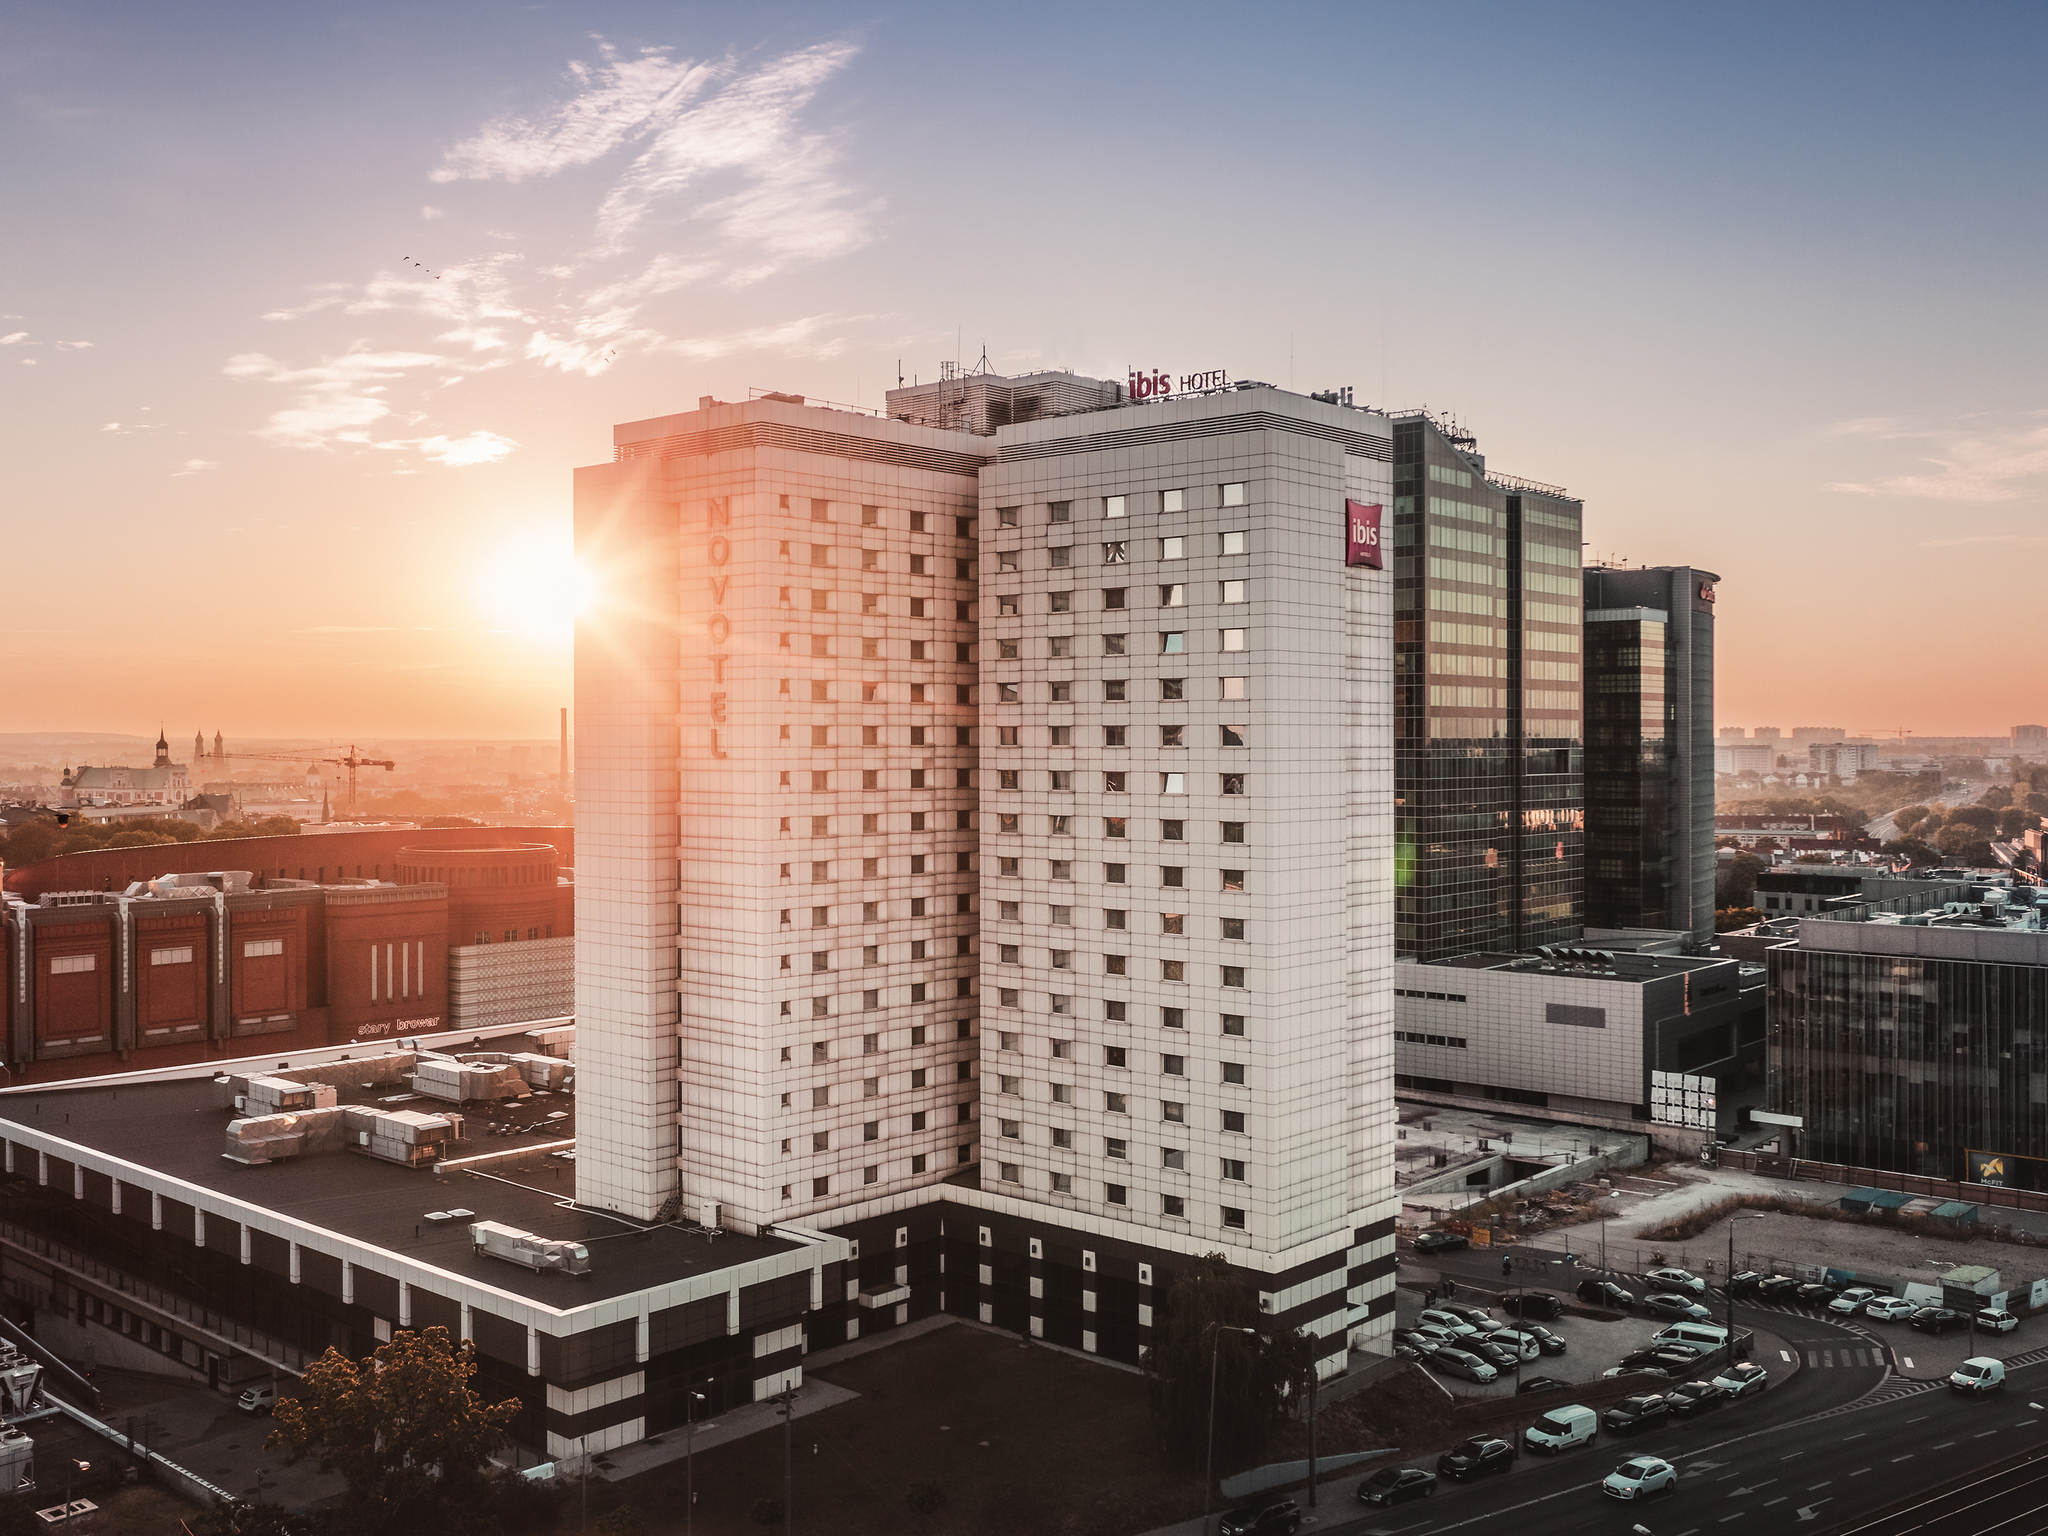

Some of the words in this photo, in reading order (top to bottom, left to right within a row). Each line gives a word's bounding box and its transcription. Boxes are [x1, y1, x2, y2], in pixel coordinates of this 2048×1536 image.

[1129, 369, 1171, 399] ibis
[1180, 369, 1231, 392] HOTEL
[1352, 518, 1377, 546] ibis
[707, 495, 730, 760] NOVOTEL
[357, 1022, 391, 1036] stary
[396, 1016, 440, 1031] browar
